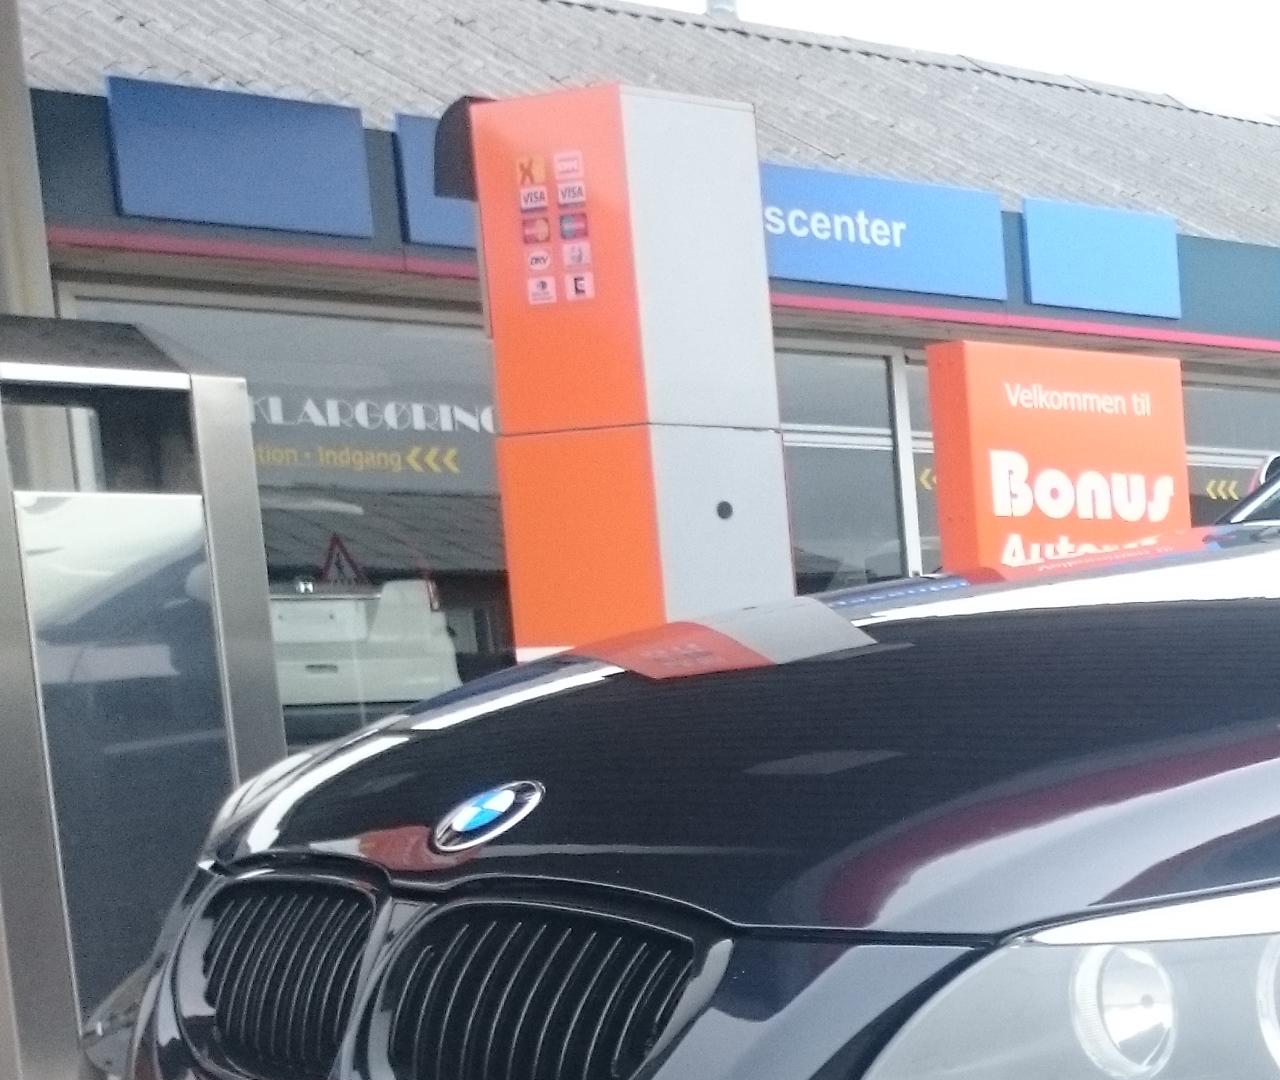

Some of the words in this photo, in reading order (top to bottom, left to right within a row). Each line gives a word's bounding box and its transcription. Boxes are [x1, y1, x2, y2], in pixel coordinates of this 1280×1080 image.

[523, 191, 545, 206] VISA
[561, 186, 583, 199] VISA
[763, 206, 907, 248] scenter
[1004, 382, 1127, 415] Velkommen
[1131, 391, 1151, 416] til
[318, 446, 402, 473] Indgang
[988, 449, 1175, 522] Bonus
